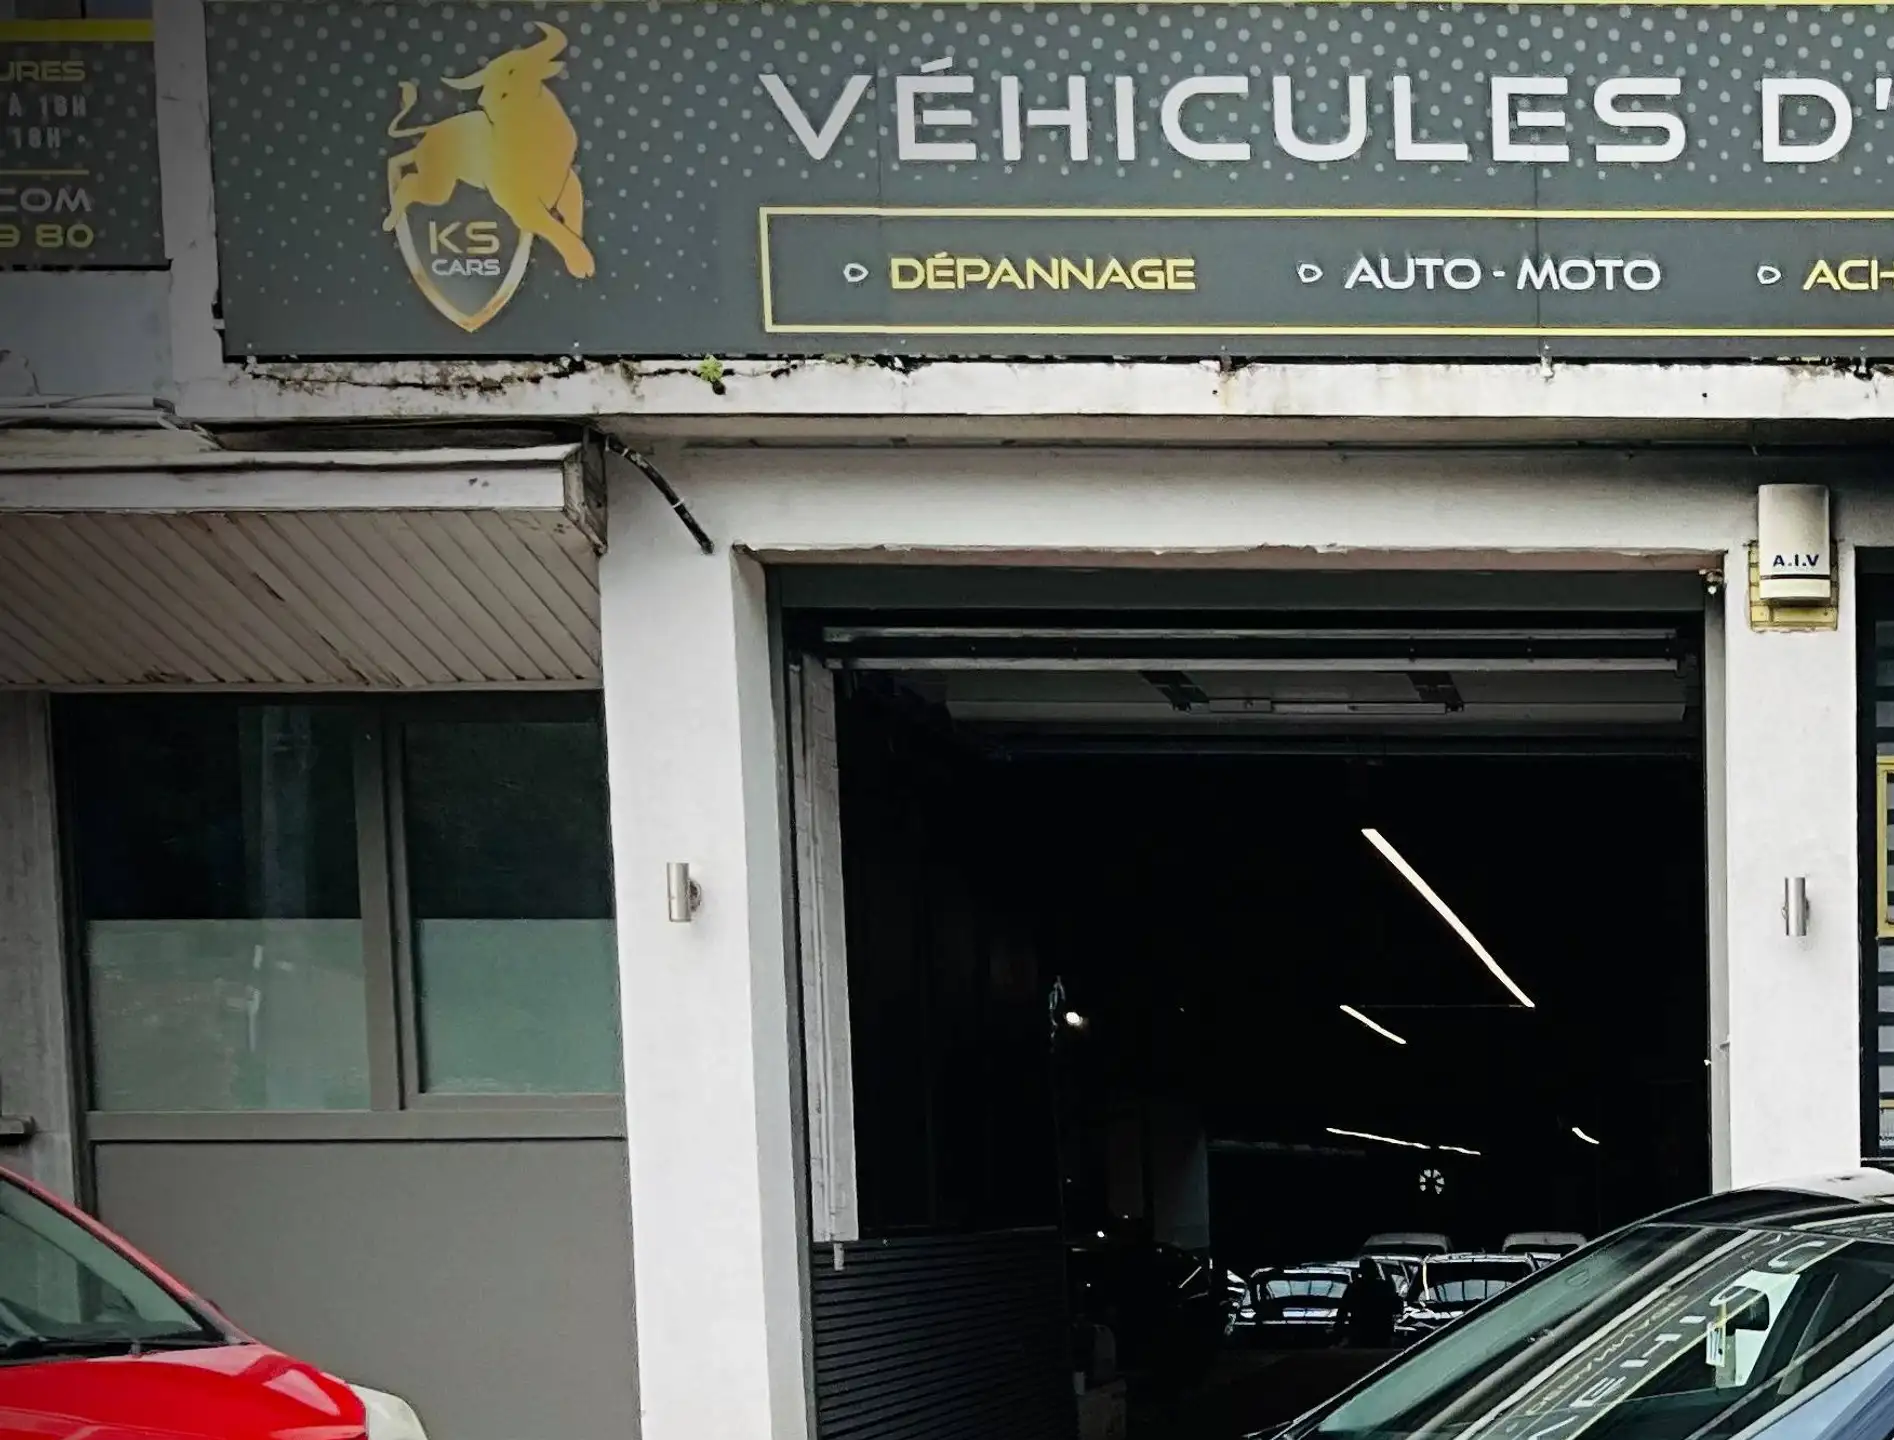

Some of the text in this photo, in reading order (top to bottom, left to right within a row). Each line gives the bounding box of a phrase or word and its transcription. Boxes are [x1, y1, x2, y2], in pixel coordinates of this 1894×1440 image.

[760, 56, 1686, 163] VÉHICULES
[429, 220, 500, 255] KS
[431, 258, 501, 276] CARS
[890, 252, 1196, 290] DÉPANNAGE
[1344, 256, 1482, 290] AUTO
[1516, 257, 1661, 291] MOTO
